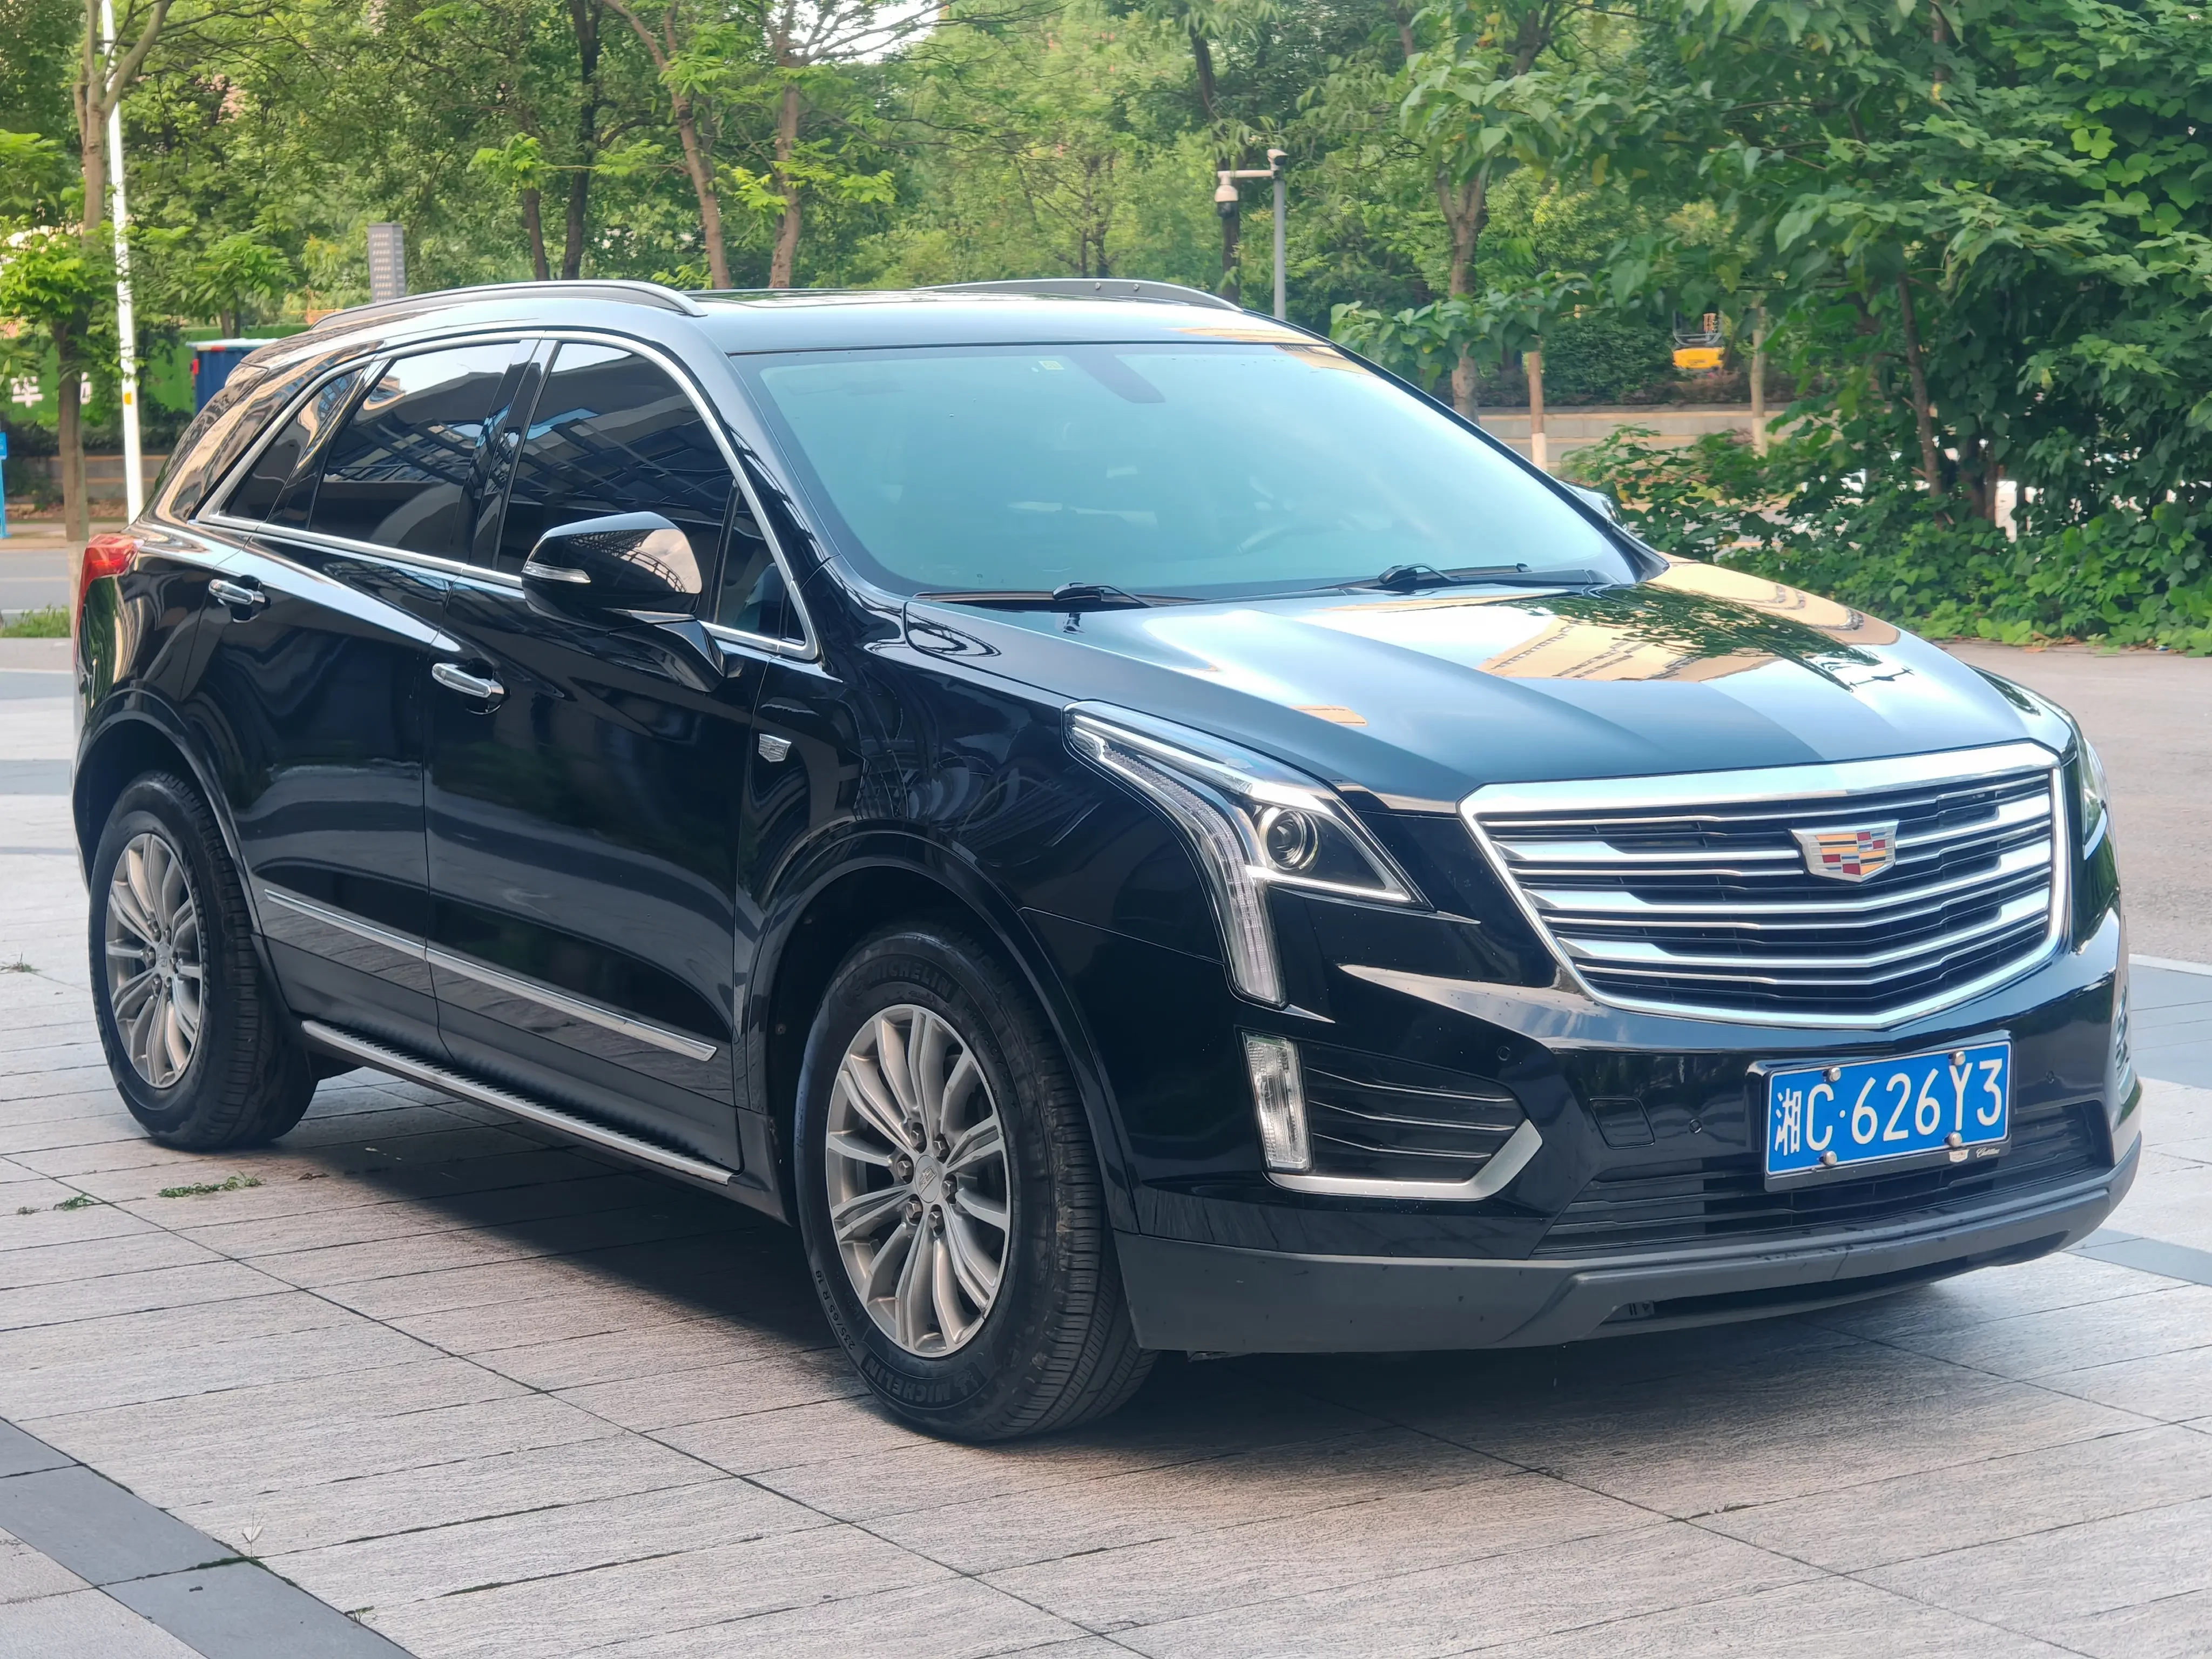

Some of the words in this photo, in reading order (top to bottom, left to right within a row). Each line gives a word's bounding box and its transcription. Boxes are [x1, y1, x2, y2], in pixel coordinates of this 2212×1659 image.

[870, 960, 953, 998] MICHELIN
[815, 1270, 824, 1285] 18
[822, 1290, 830, 1300] R
[828, 1304, 856, 1350] 235/65
[865, 1357, 950, 1403] MICHELIN
